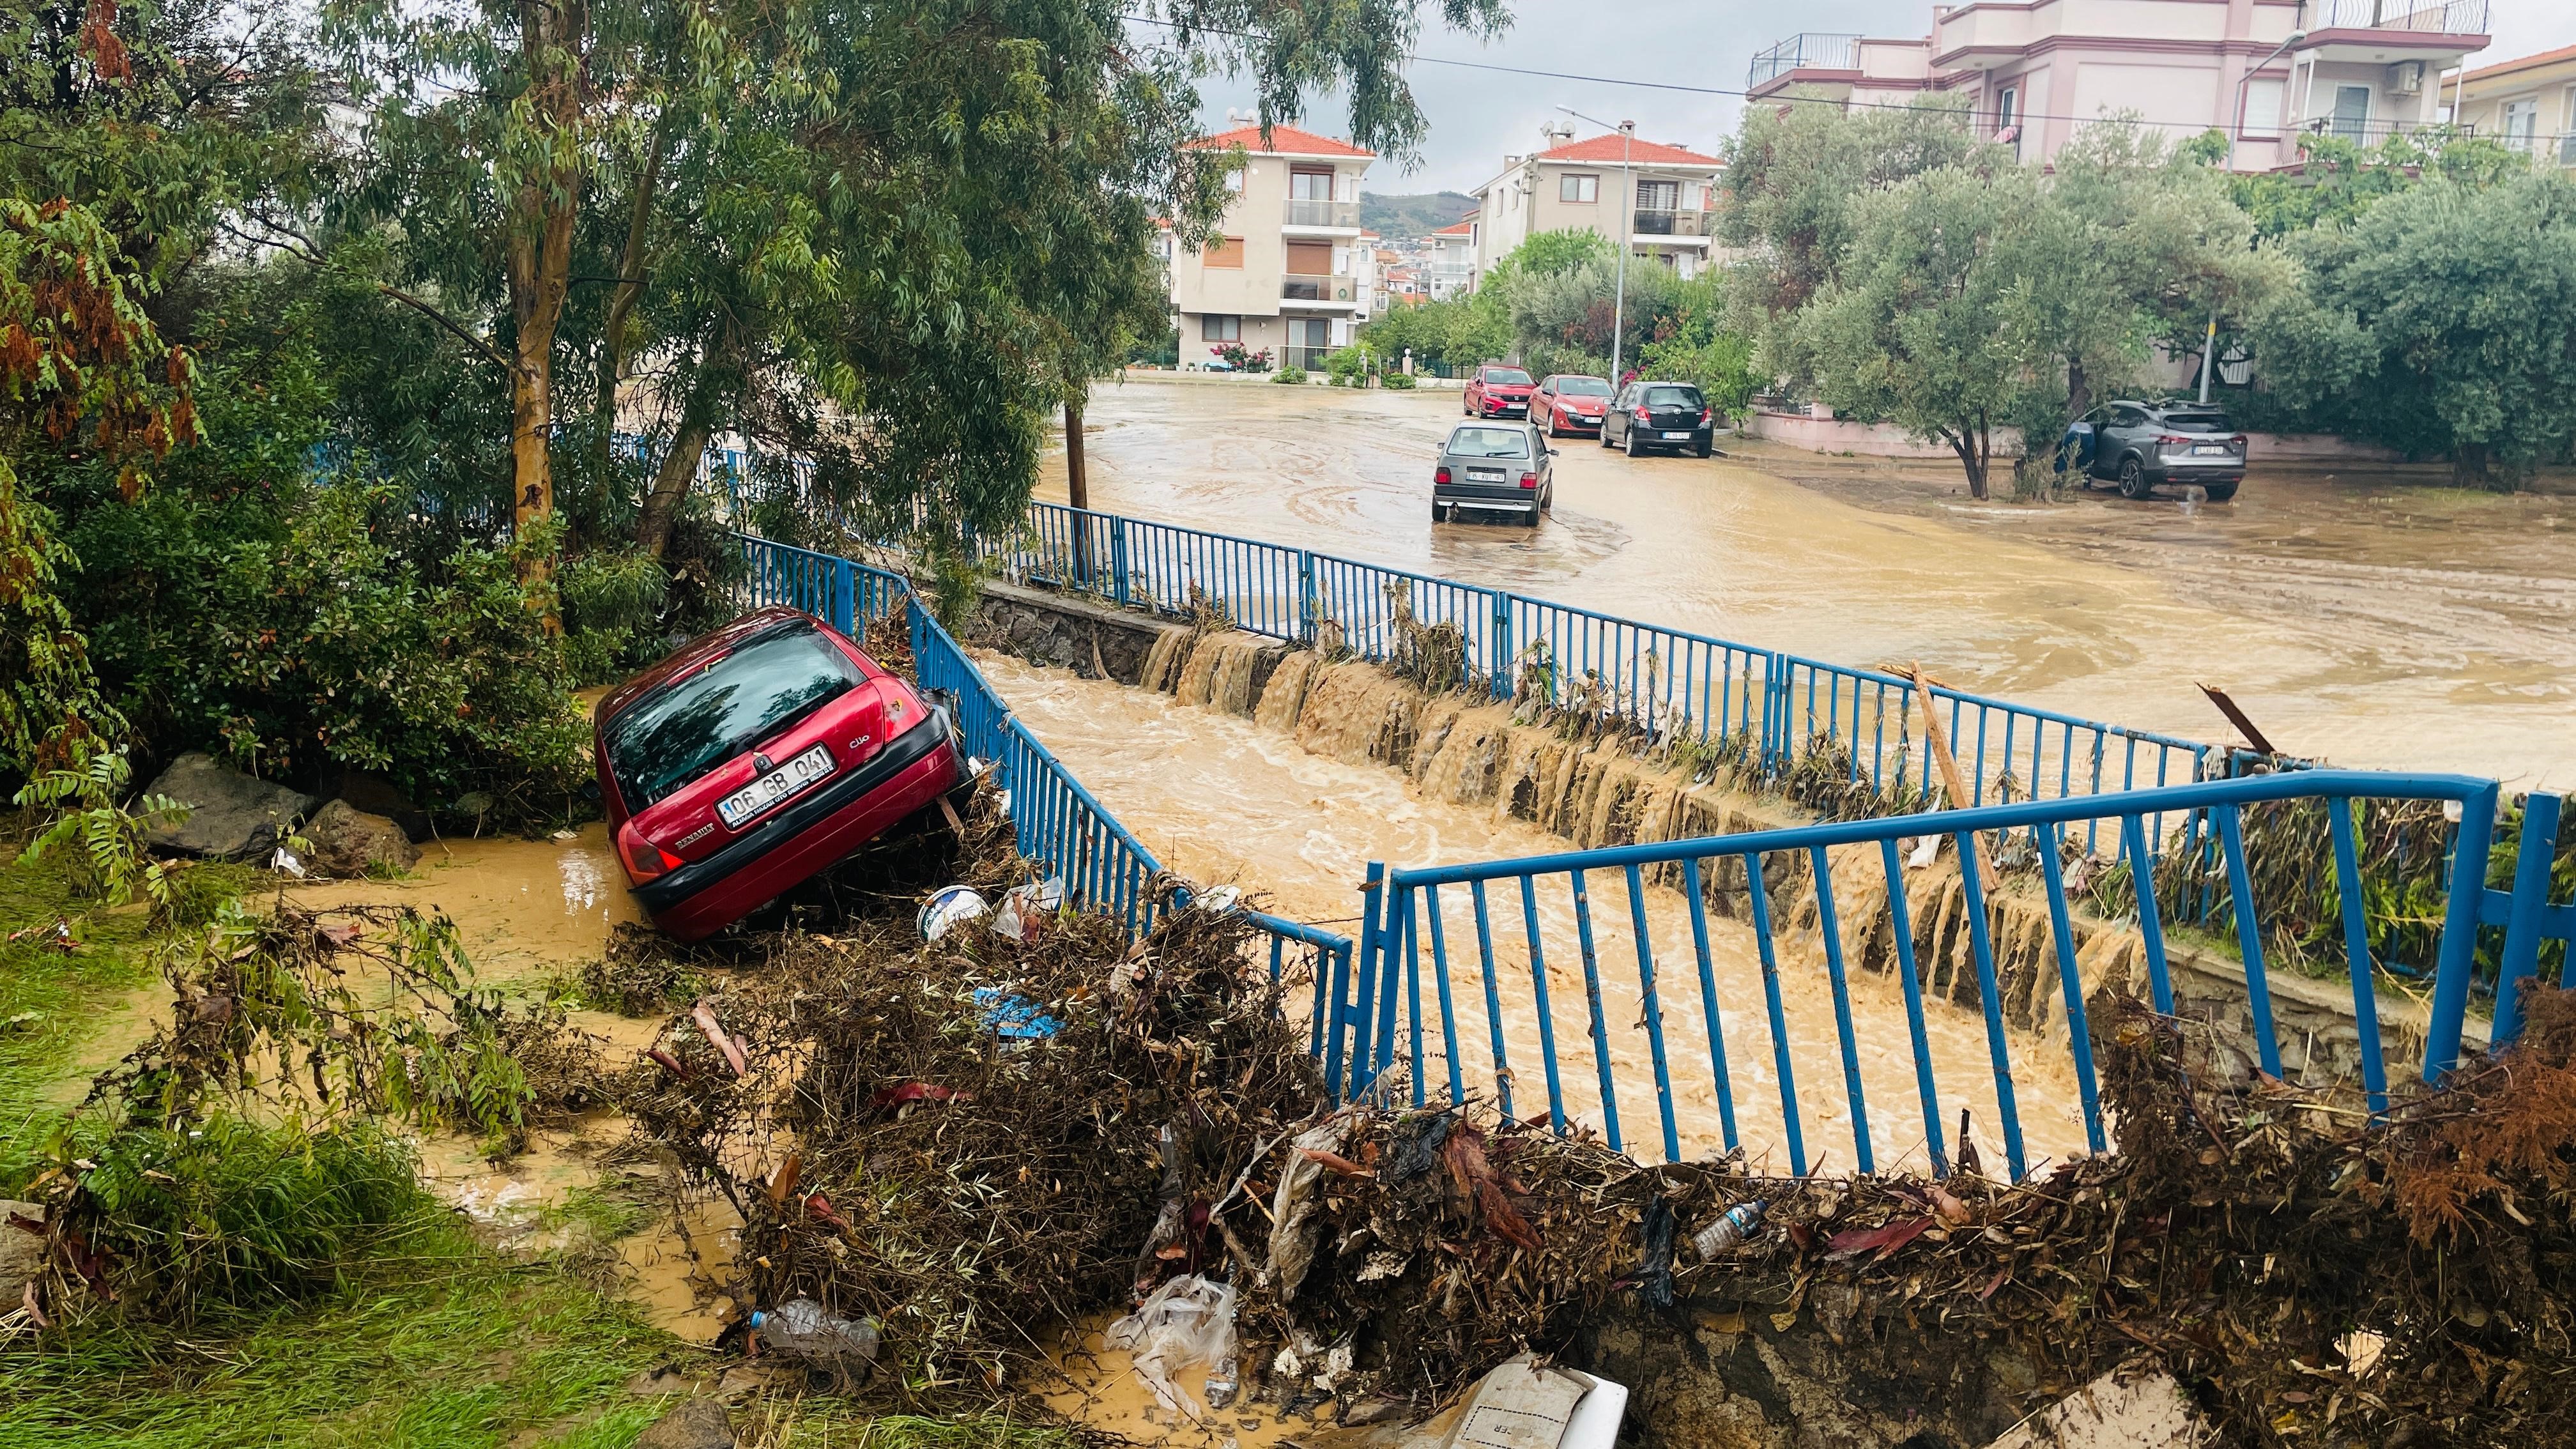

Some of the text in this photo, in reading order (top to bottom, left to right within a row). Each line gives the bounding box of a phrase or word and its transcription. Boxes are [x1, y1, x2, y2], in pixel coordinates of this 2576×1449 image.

[730, 791, 756, 815] 06
[762, 772, 789, 796] GB
[795, 749, 829, 778] 041
[675, 822, 715, 850] RENAULT
